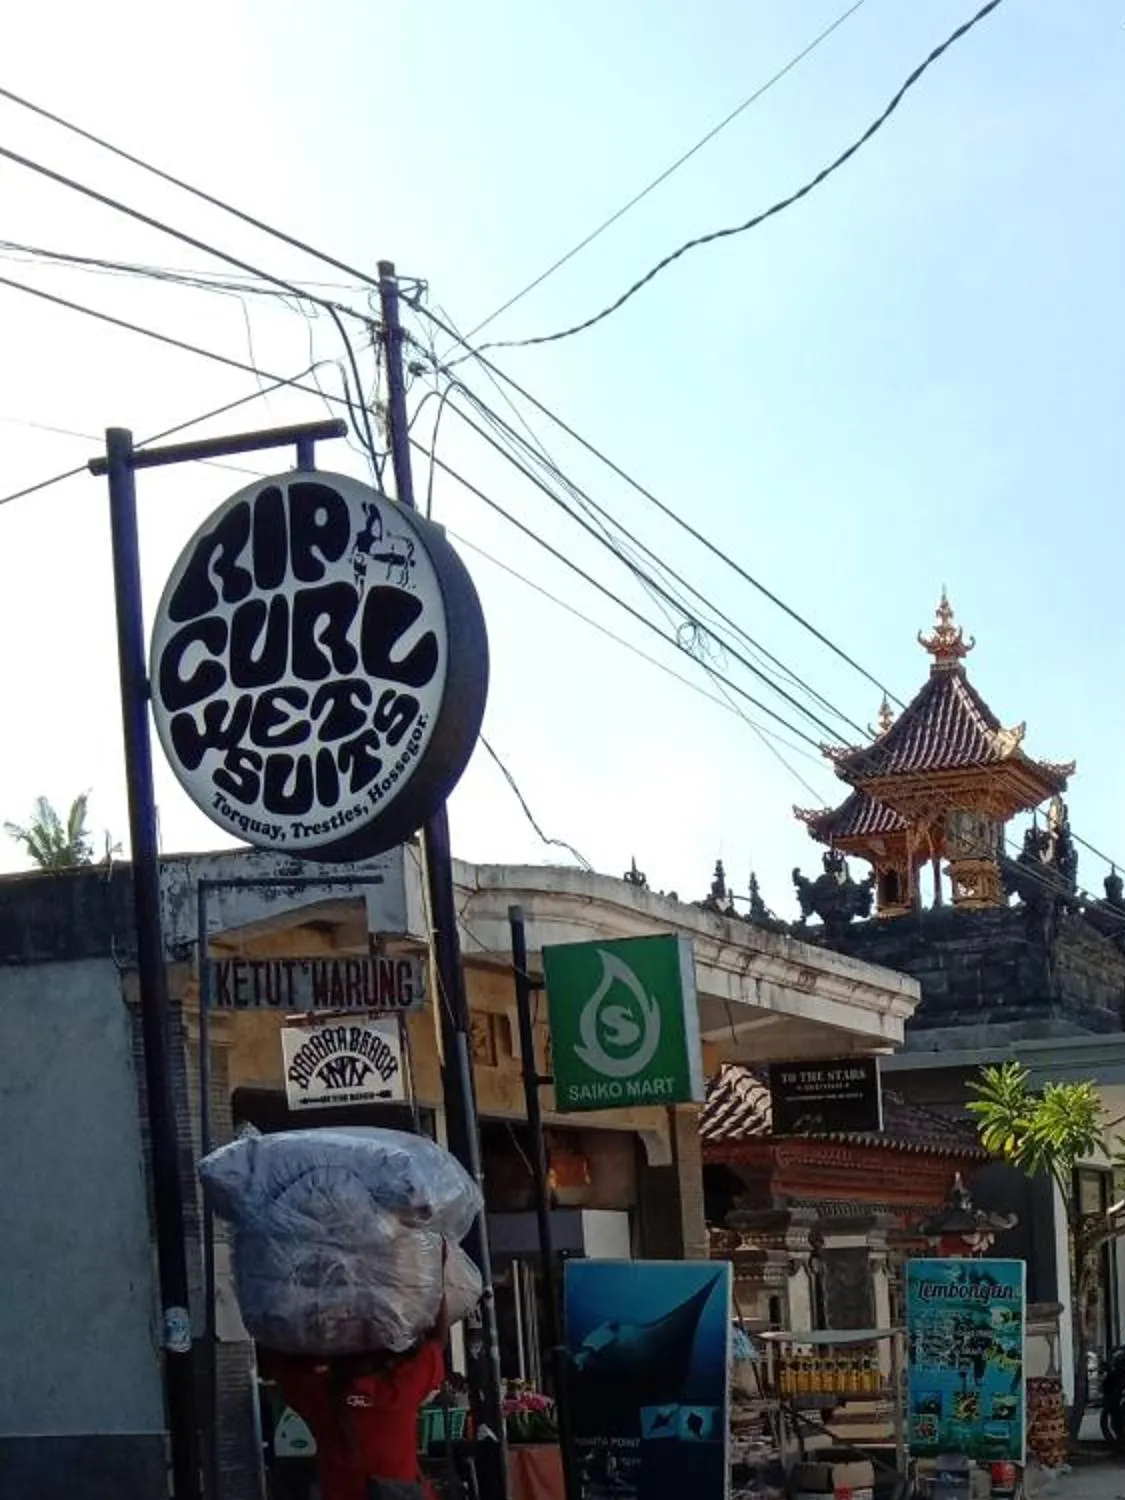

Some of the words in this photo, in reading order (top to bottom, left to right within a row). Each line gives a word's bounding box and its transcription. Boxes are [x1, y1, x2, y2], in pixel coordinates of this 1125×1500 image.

[168, 482, 350, 623] RIP
[158, 581, 439, 713] CURL
[211, 791, 287, 842] Torquay,
[569, 1081, 623, 1101] SAIKO
[626, 1077, 675, 1097] MART
